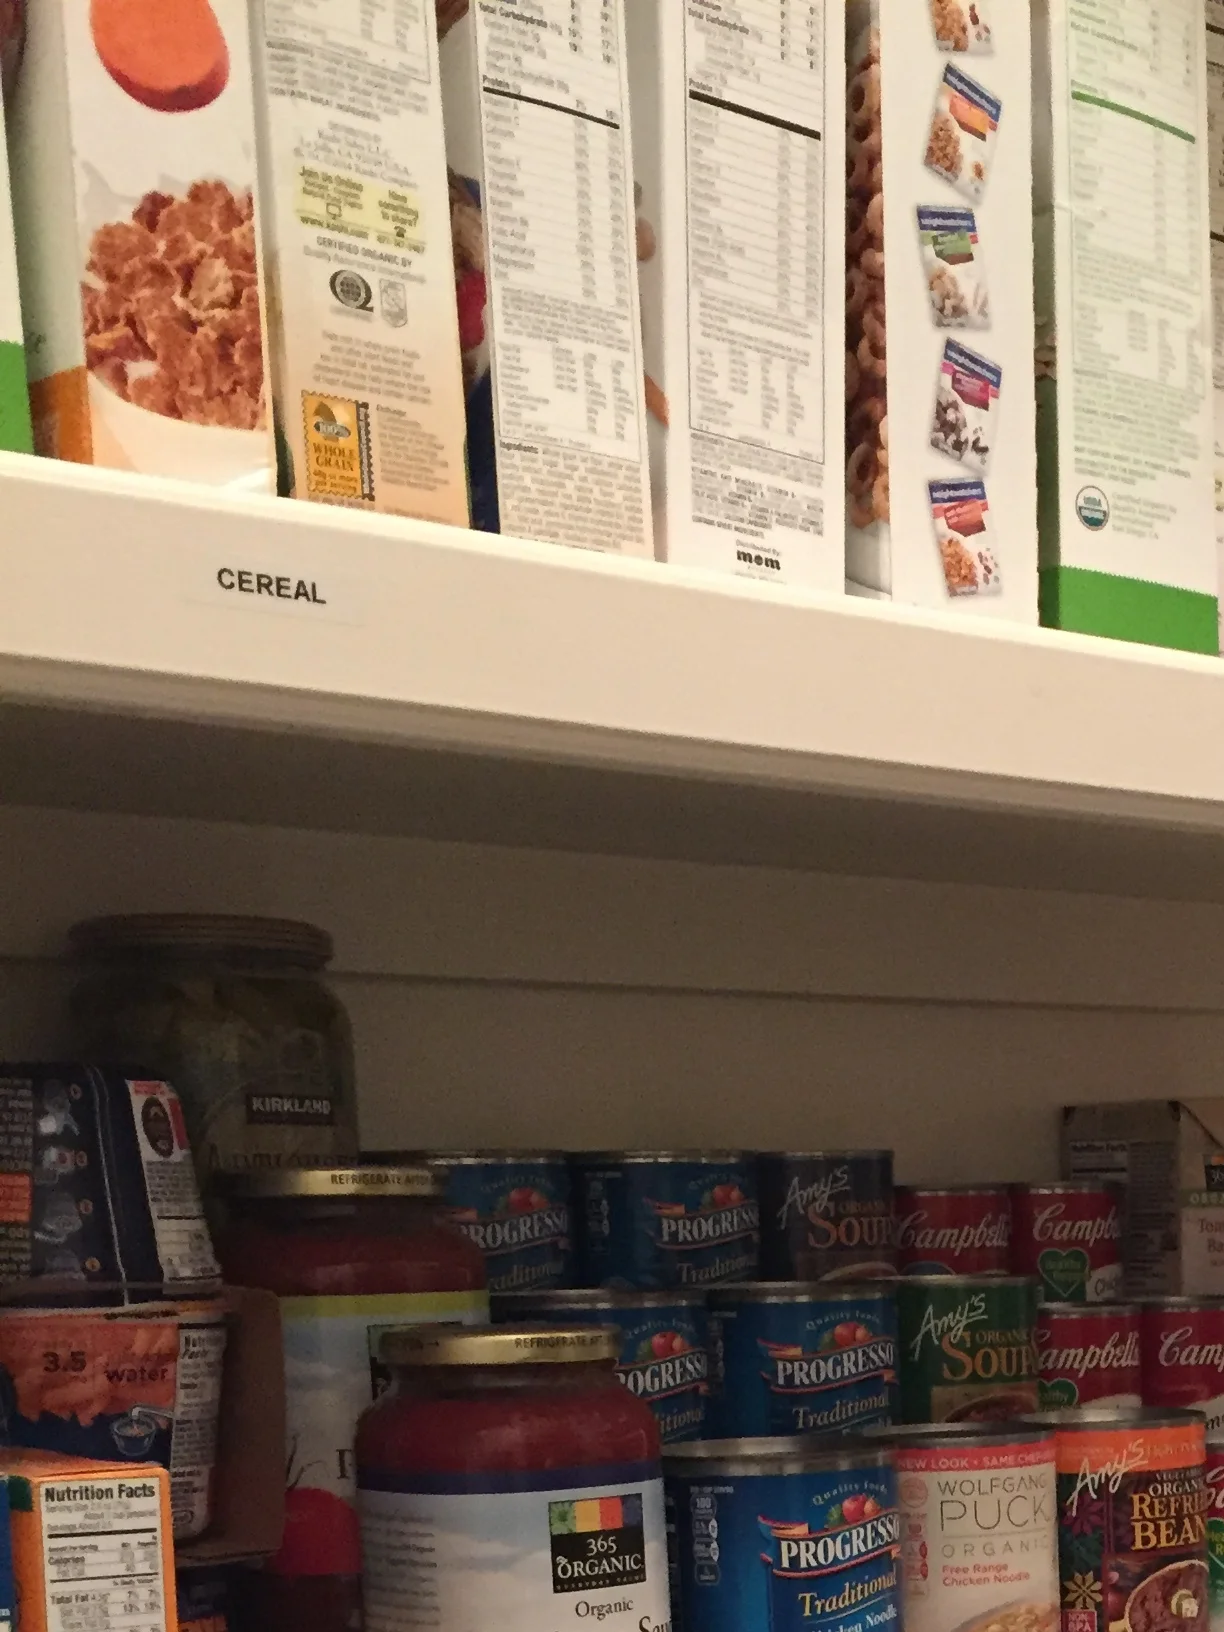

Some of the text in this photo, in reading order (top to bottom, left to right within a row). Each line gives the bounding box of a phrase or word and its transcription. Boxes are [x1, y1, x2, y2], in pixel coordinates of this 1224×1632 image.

[217, 567, 326, 604] CEREAL
[252, 1097, 331, 1115] KIRKLAND
[910, 1293, 988, 1361] Amy's
[43, 1350, 87, 1374] 3.5
[776, 1342, 895, 1387] PROGRESSO
[104, 1366, 168, 1385] water
[792, 1393, 890, 1431] Traditional
[931, 1455, 969, 1469] LOOK
[937, 1472, 1049, 1498] WOLFGANG
[1066, 1438, 1148, 1517] Amy's
[45, 1483, 156, 1502] Nutrition Facts
[812, 1482, 861, 1505] Quality
[940, 1493, 1051, 1533] PUCK
[586, 1534, 618, 1558] 365
[941, 1533, 1051, 1559] ORGANIC
[556, 1553, 644, 1579] ORGANIC
[942, 1561, 1010, 1577] Free Range
[942, 1570, 1031, 1588] Chicken Noodle
[798, 1570, 897, 1618] Traditional
[575, 1597, 634, 1621] Organic
